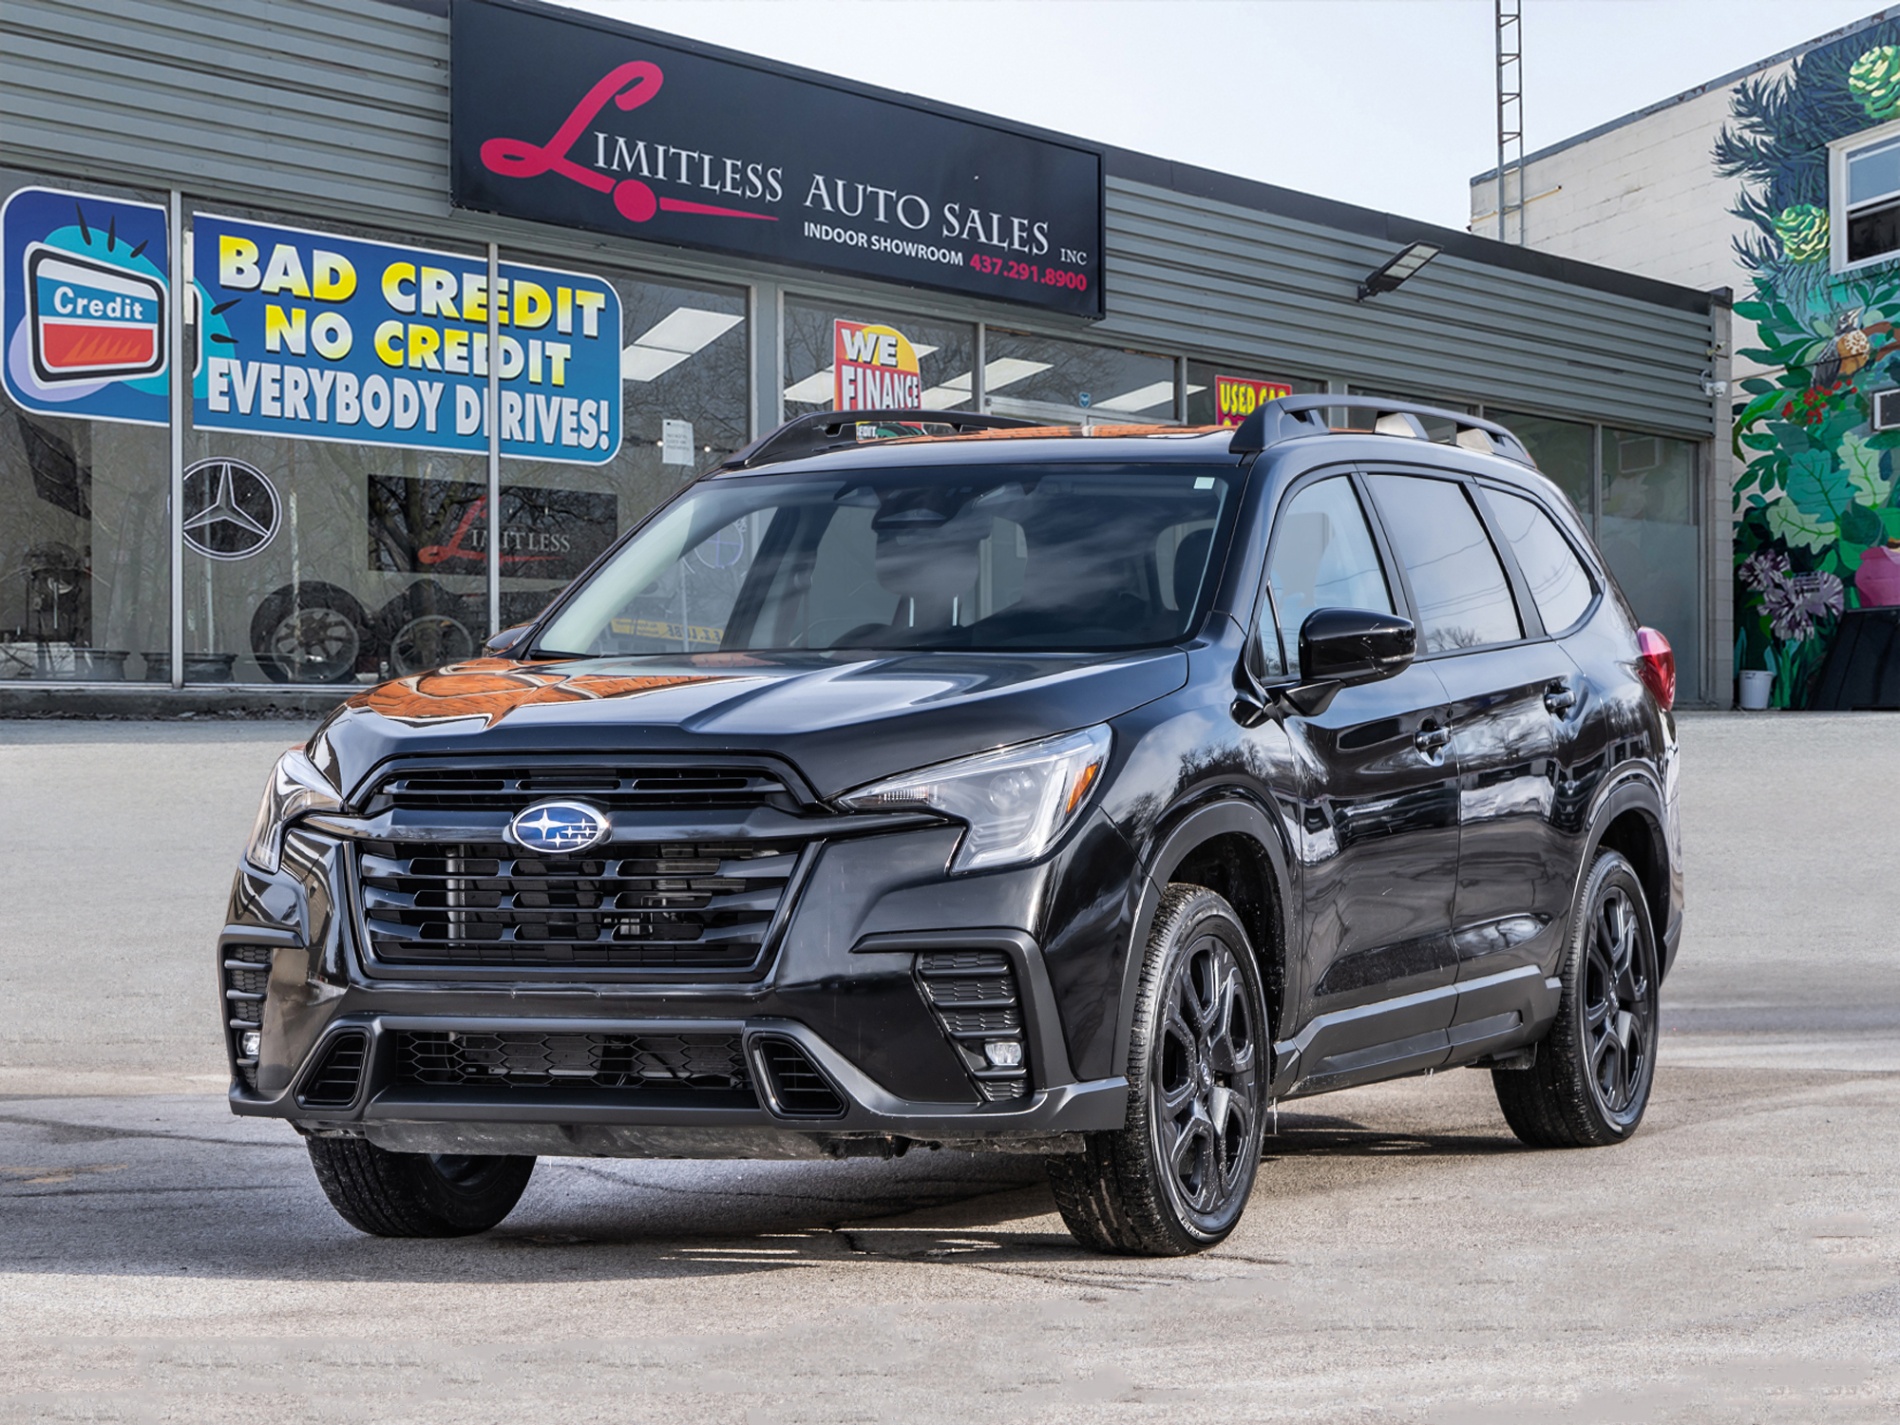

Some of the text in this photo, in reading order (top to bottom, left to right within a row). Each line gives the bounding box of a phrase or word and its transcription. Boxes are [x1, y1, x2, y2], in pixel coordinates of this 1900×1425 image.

[480, 60, 1088, 265] LIMITLESS AUTO SALES INC
[219, 235, 606, 338] BAD CREDIT
[804, 221, 1088, 291] INDOOR SHOWROOM 437.291.8900
[53, 286, 143, 320] Credit
[265, 304, 572, 387] NO CREDIT
[841, 328, 898, 367] WE
[208, 356, 445, 432] EVERYBODY
[456, 384, 610, 451] DRIVES!
[841, 364, 919, 410] FINANCE
[1220, 382, 1256, 416] USED
